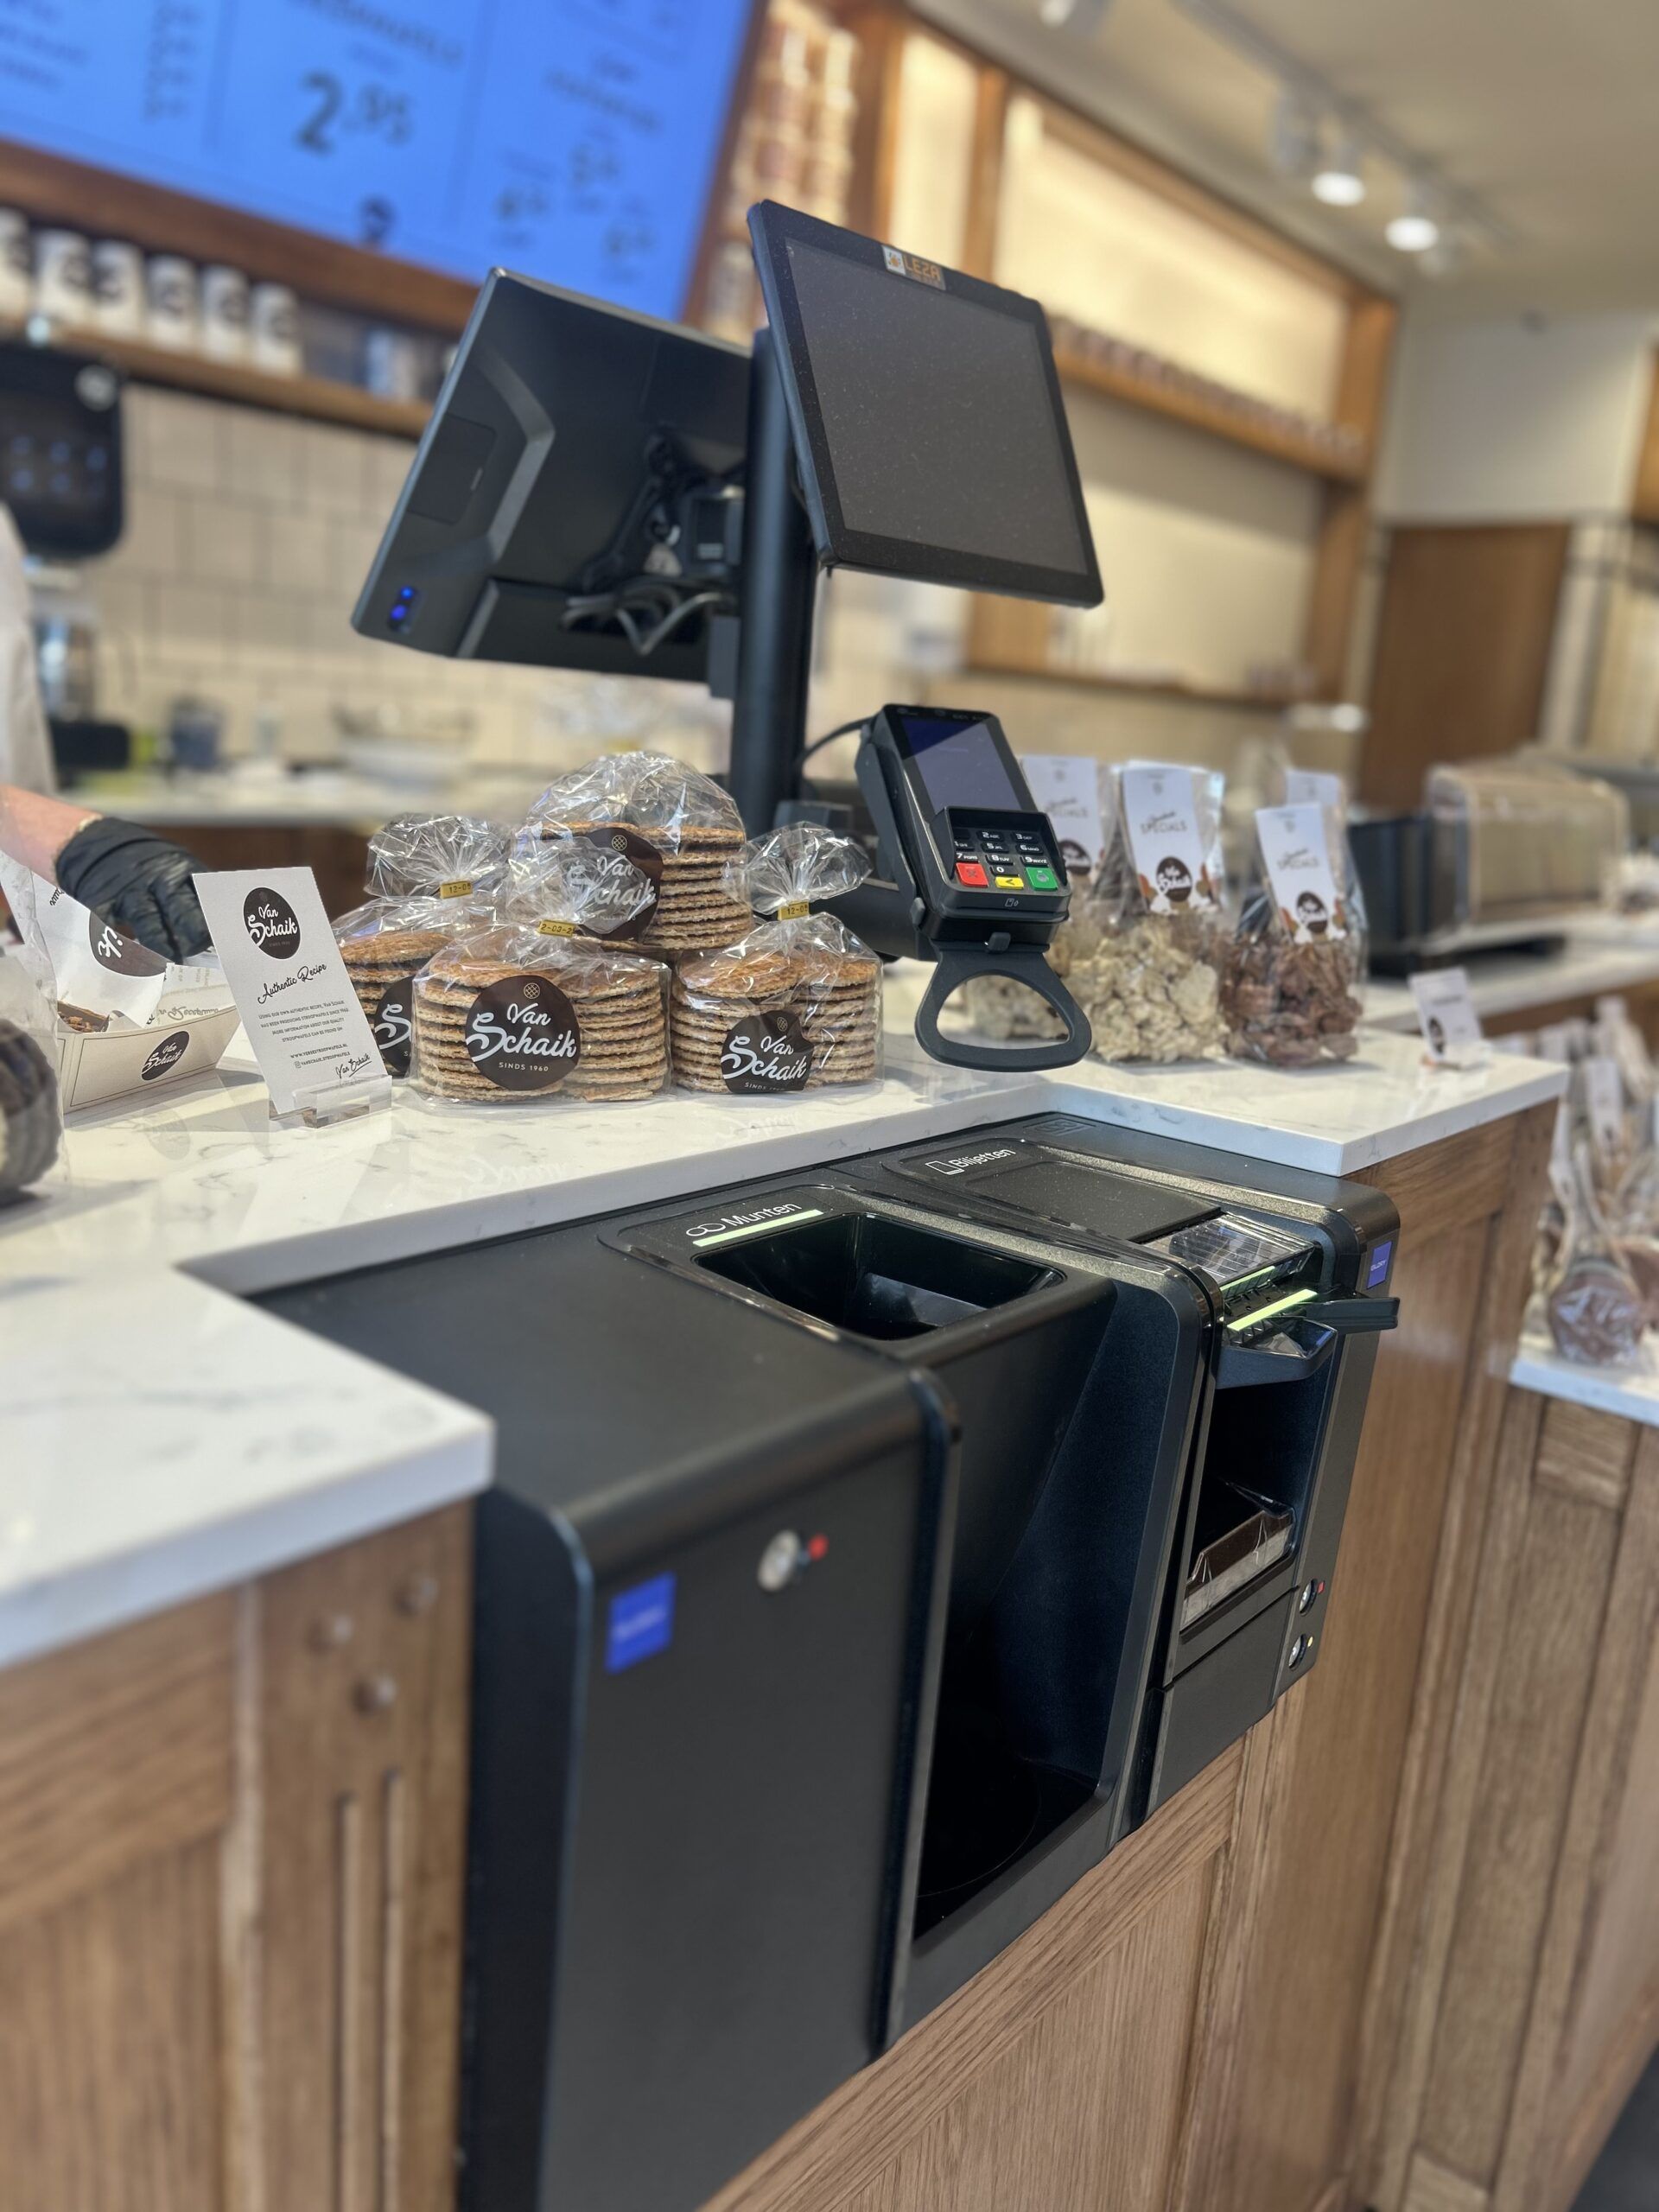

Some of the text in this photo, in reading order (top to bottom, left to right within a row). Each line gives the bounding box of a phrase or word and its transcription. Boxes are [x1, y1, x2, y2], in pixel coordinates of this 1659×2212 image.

[257, 904, 279, 919] Van
[247, 914, 298, 947] Schaik
[257, 963, 327, 1004] Authentic Recipe
[506, 1002, 552, 1027] Van
[466, 1012, 577, 1062] Schaik
[760, 1035, 794, 1055] Van
[499, 1062, 526, 1071] SINDS
[721, 1036, 807, 1080] Schaik
[948, 1148, 1017, 1169] Biljetten
[721, 1203, 803, 1227] Munten
